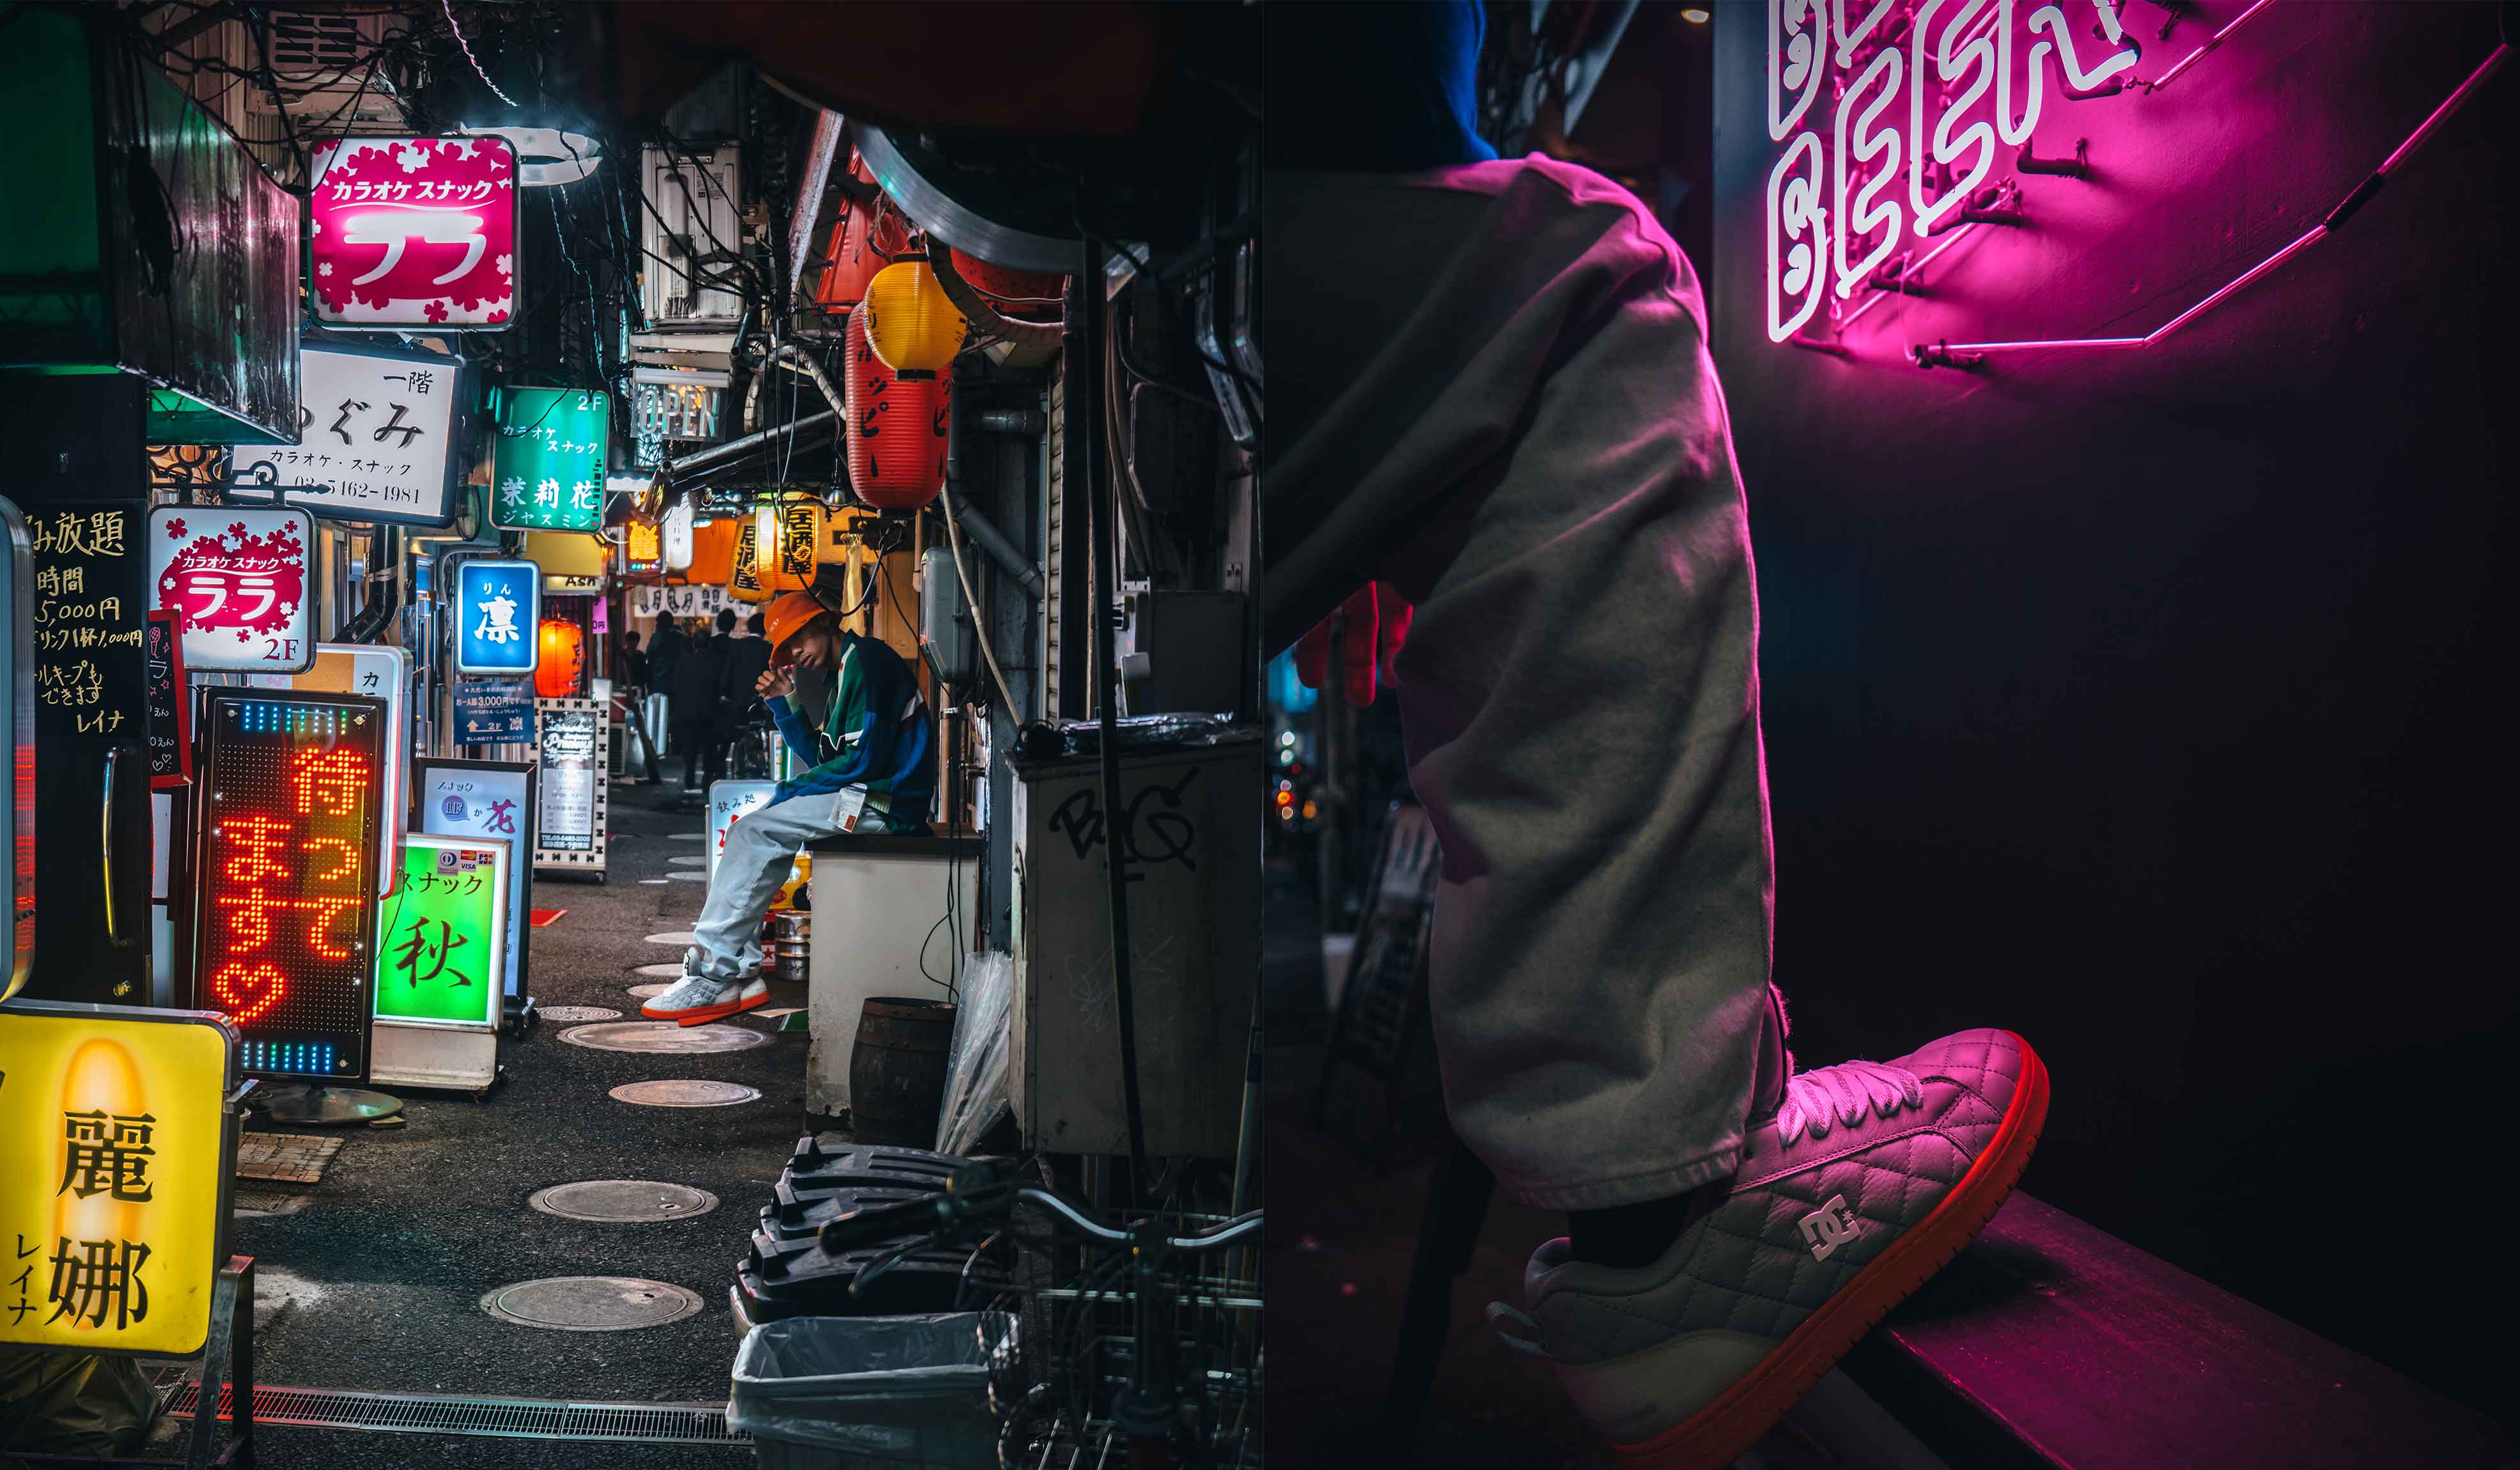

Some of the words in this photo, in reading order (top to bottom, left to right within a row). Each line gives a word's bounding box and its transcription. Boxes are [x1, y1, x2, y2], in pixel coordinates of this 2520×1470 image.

[332, 180, 412, 200] カラオケ
[415, 181, 492, 200] スナック
[384, 369, 434, 394] 一階
[577, 396, 602, 411] 2F
[638, 389, 720, 437] OPEN
[502, 425, 556, 440] カラオケ
[547, 440, 598, 454] スナック
[501, 476, 597, 510] 茉莉花
[502, 511, 590, 528] ジャスミン
[26, 511, 125, 557] み放題
[182, 555, 231, 569] カラオケ
[232, 557, 279, 570] スナック
[37, 565, 84, 596] 時間
[483, 582, 511, 594] りん
[188, 576, 276, 621] ララ
[34, 596, 121, 629] 5,000円
[34, 627, 143, 651] リンク1杯1,000円
[262, 638, 299, 661] 2F
[34, 660, 104, 686] ルキープも
[41, 685, 103, 706] できます
[77, 709, 125, 733] レイナ
[438, 782, 474, 792] スナック
[481, 798, 517, 833] 花
[716, 794, 756, 814] 飲み処
[392, 916, 472, 989] 秋
[44, 1108, 157, 1331] 麗娜
[8, 1234, 42, 1327] レイナ
